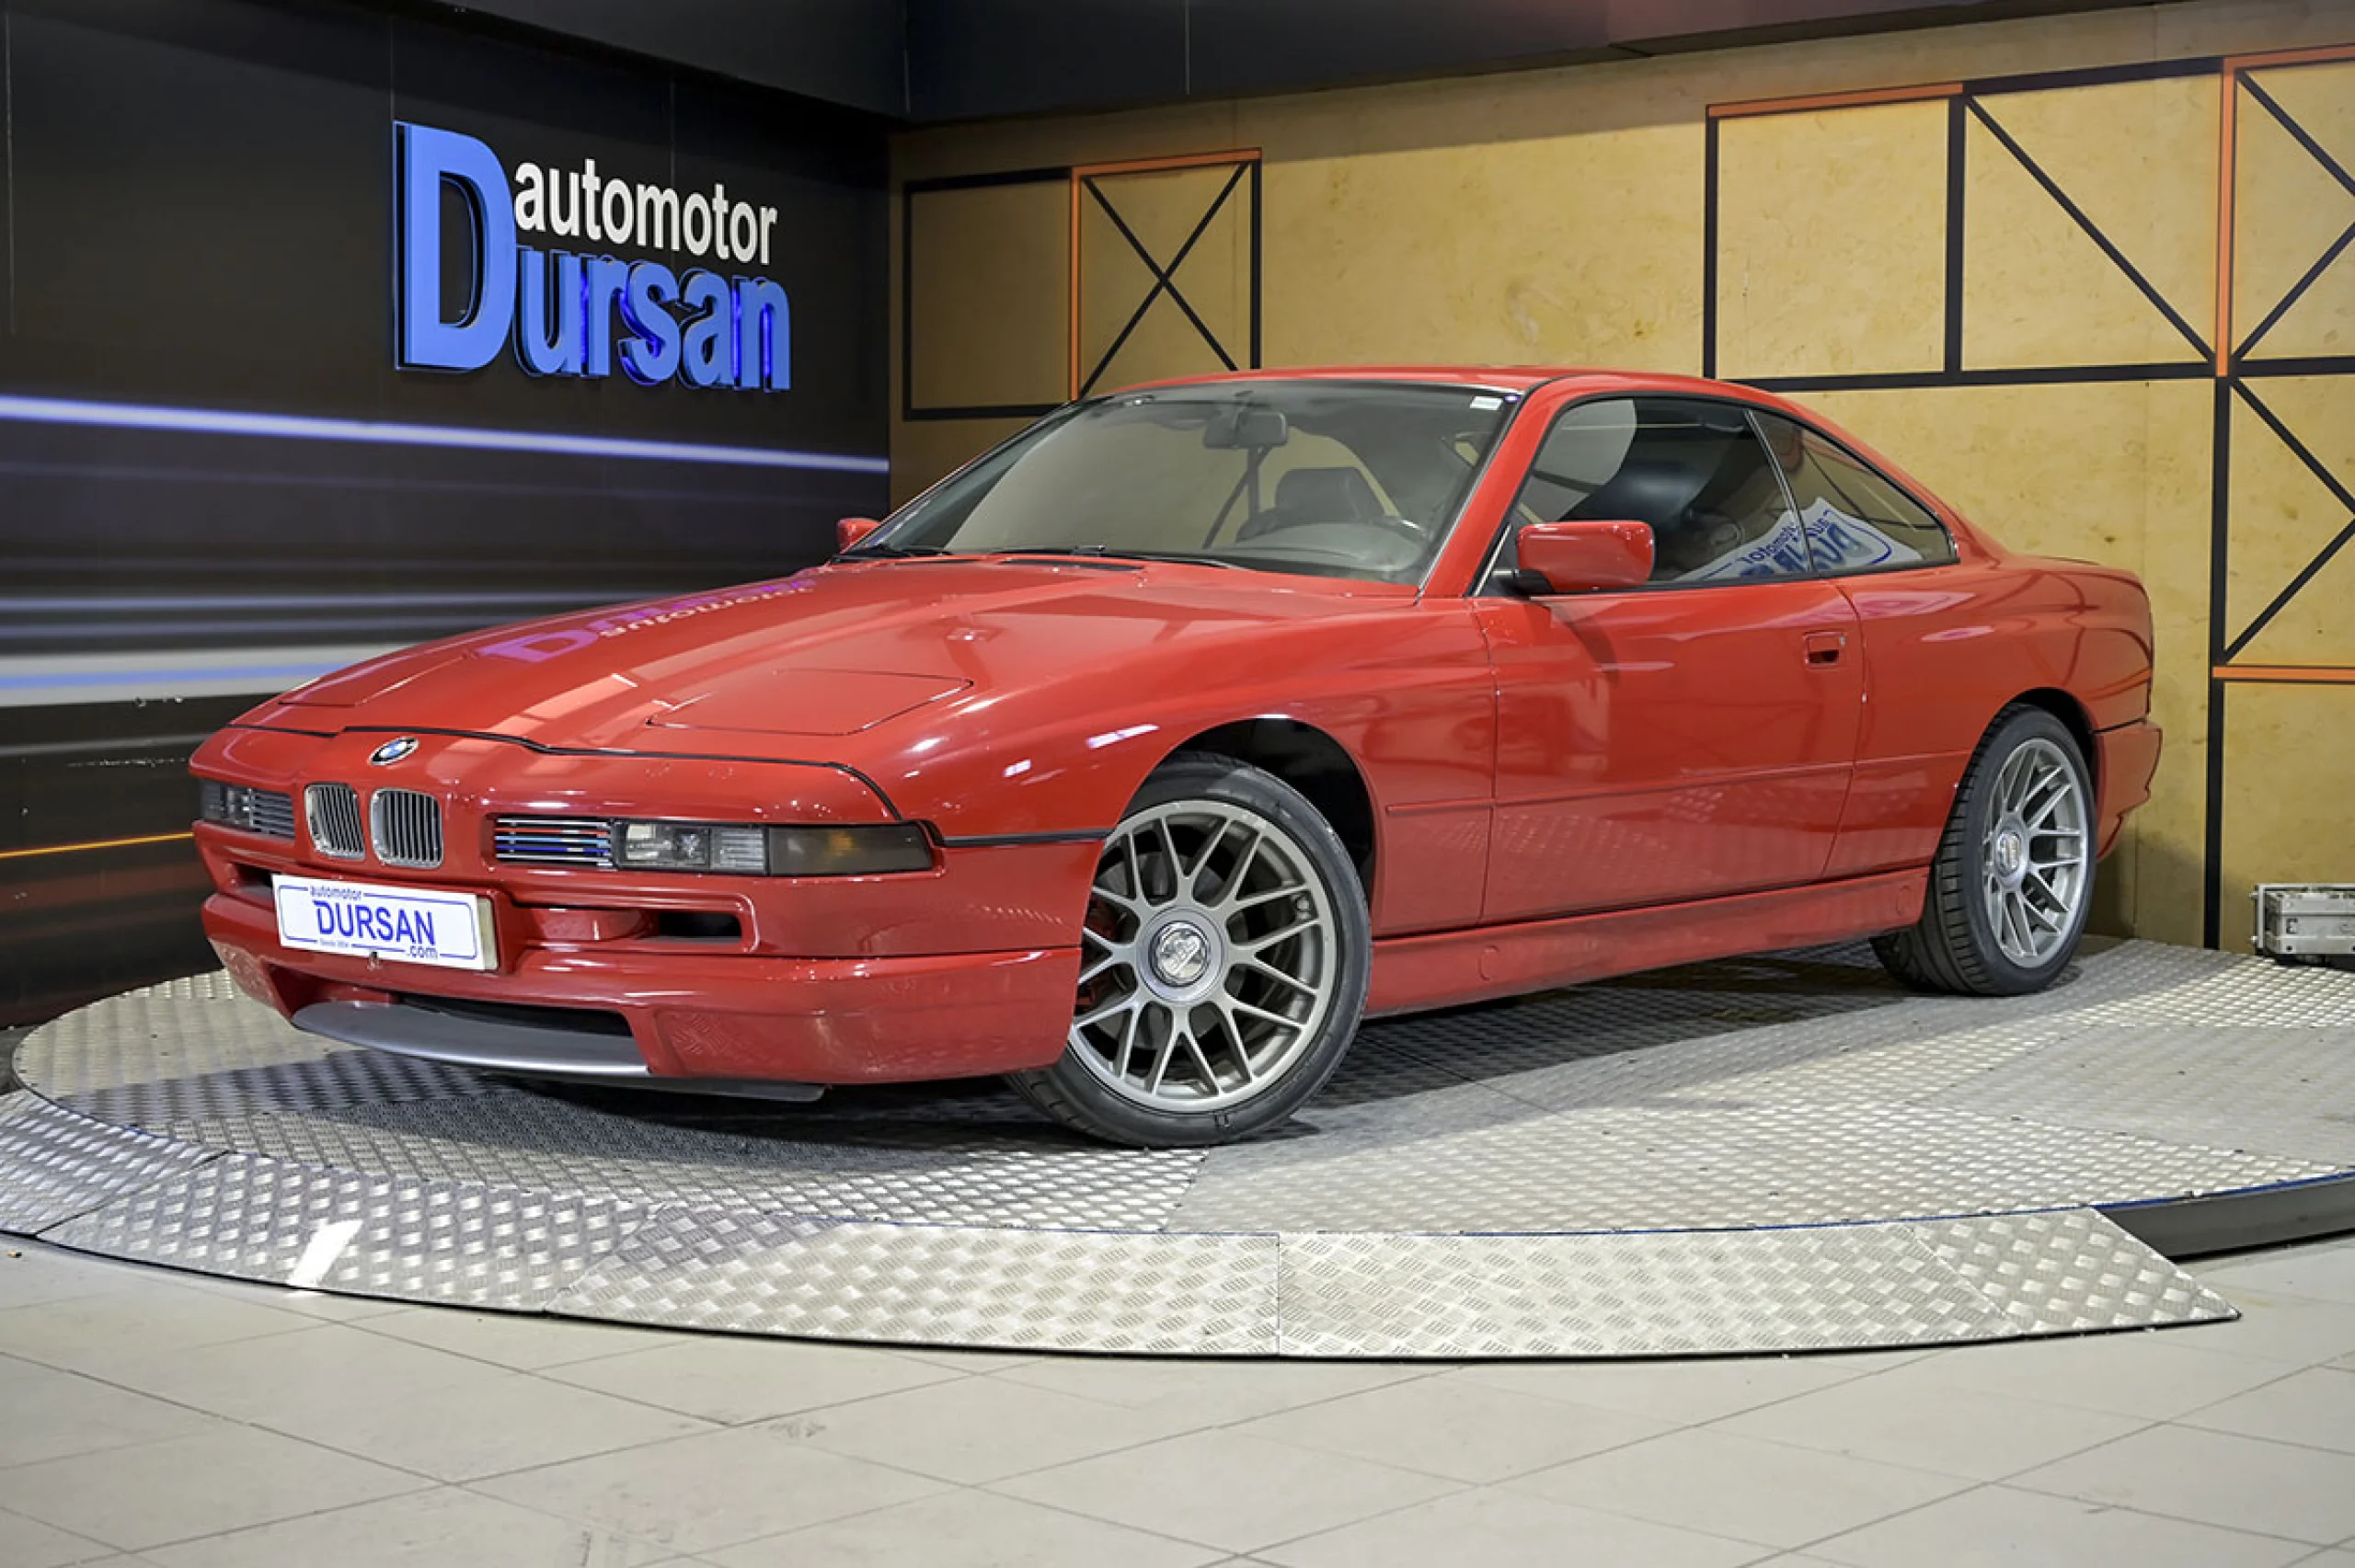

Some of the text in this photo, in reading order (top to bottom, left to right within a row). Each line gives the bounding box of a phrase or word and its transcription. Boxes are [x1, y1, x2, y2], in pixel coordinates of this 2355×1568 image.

[514, 158, 777, 265] automotor
[393, 120, 791, 392] Dursan
[309, 885, 362, 901] automotor
[313, 899, 436, 946] DURSAN
[406, 944, 439, 960] .com
